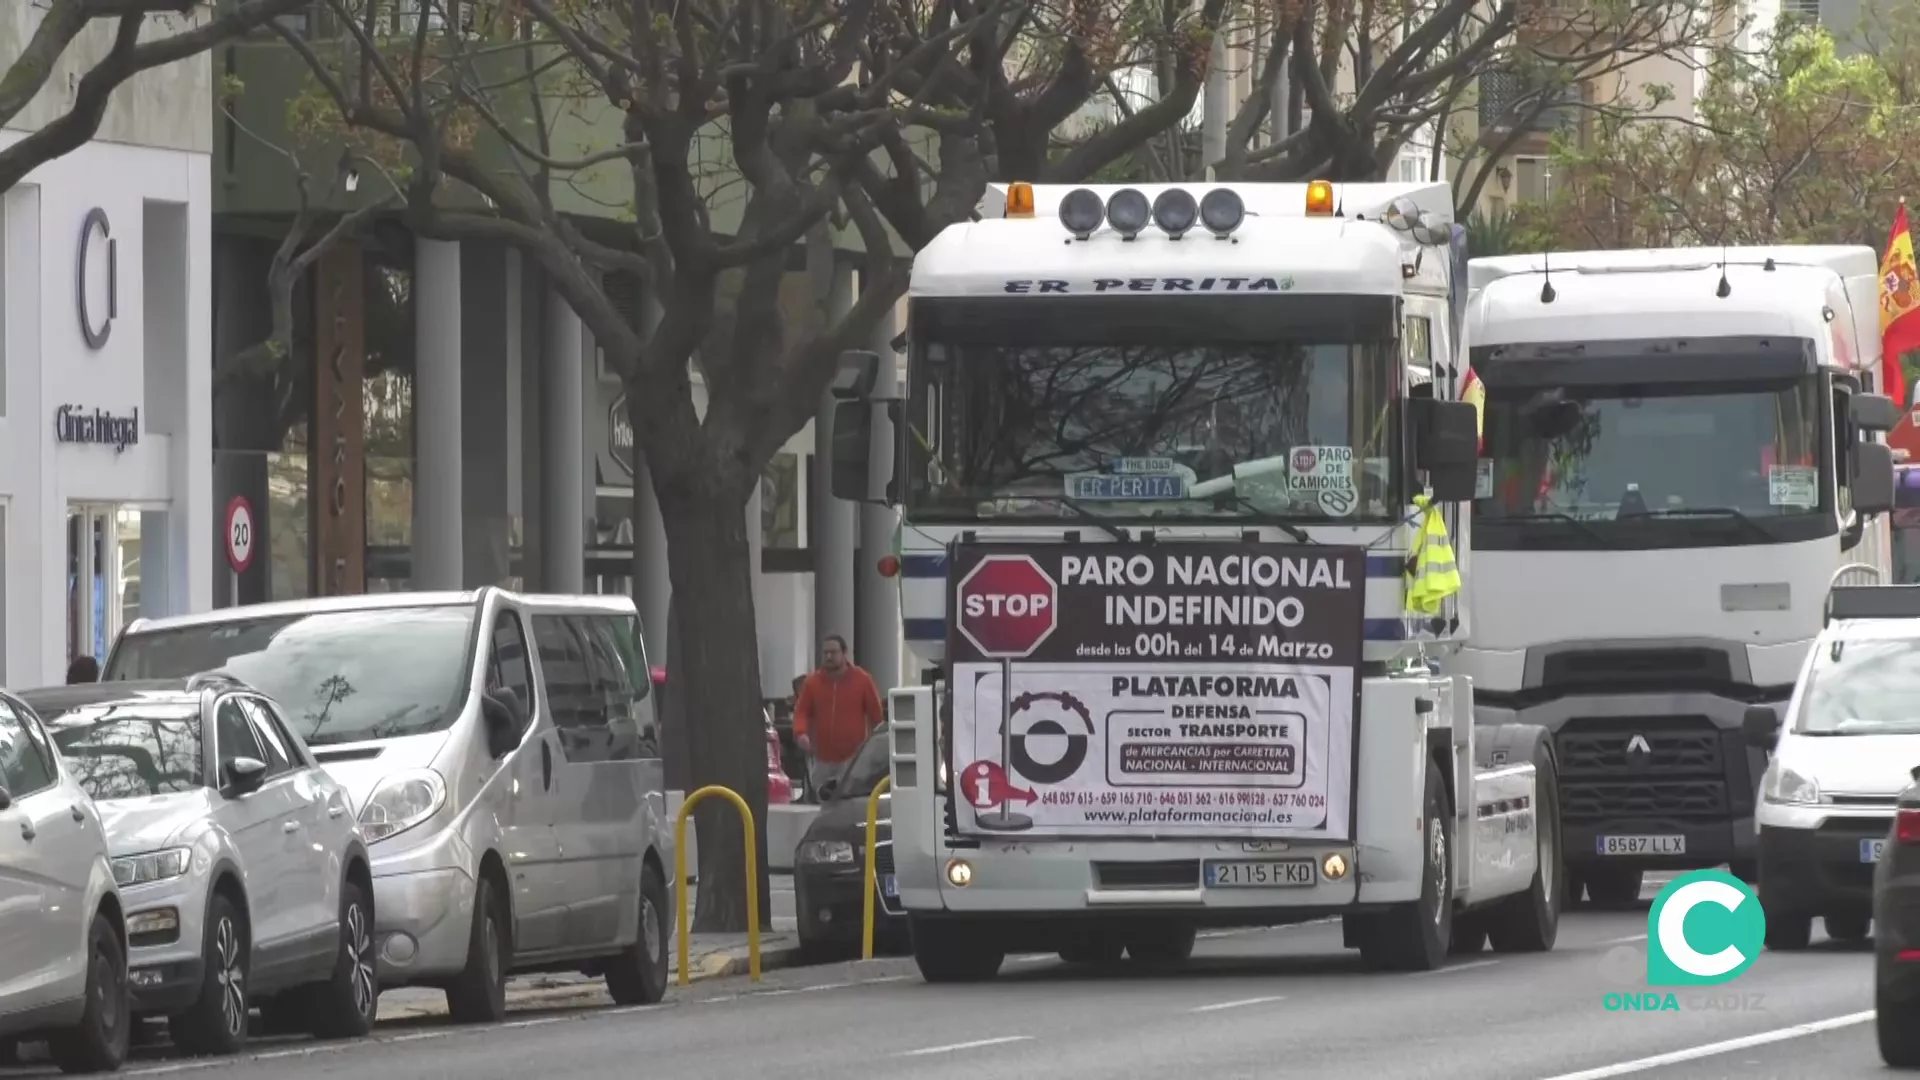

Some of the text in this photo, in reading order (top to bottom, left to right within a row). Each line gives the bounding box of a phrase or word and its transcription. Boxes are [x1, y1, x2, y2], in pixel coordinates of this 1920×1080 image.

[1004, 277, 1280, 293] ER PERITA
[96, 408, 138, 452] Integral
[1318, 448, 1351, 461] PARO
[1325, 463, 1344, 473] DE
[1081, 478, 1173, 496] ER PERITA
[1291, 475, 1351, 489] CAMIONES
[234, 524, 249, 545] 20
[1061, 554, 1350, 588] PARO NACIONAL
[966, 594, 1049, 617] STOP
[1105, 595, 1304, 627] INDEFINIDO
[1076, 631, 1334, 659] desde las 00h del 14 de Marzo
[1112, 676, 1299, 698] PLATAFORMA
[1172, 704, 1251, 719] DEFENSA
[1127, 723, 1289, 738] SECTOR TRANSPORTE
[1125, 745, 1290, 759] de MERCANCIAS por CARRETERA
[1125, 760, 1187, 771] NACIONAL
[1199, 760, 1290, 772] INTERNACIONAL
[1042, 791, 1058, 804] 648
[1060, 791, 1076, 804] 057
[1077, 791, 1093, 805] 615
[1100, 791, 1117, 805] 659
[1120, 791, 1135, 805] 165
[1136, 791, 1153, 805] 710
[1160, 791, 1176, 805] 646
[1177, 791, 1193, 805] 051
[1196, 791, 1211, 805] 562
[1219, 791, 1235, 805] 616
[1272, 793, 1288, 806] 637
[1290, 793, 1306, 807] 760
[1308, 794, 1325, 808] 024
[1084, 808, 1293, 824] www.plataformanacional.es
[1608, 837, 1682, 852] 8587 LLX
[1218, 864, 1310, 883] 2115 FKD
